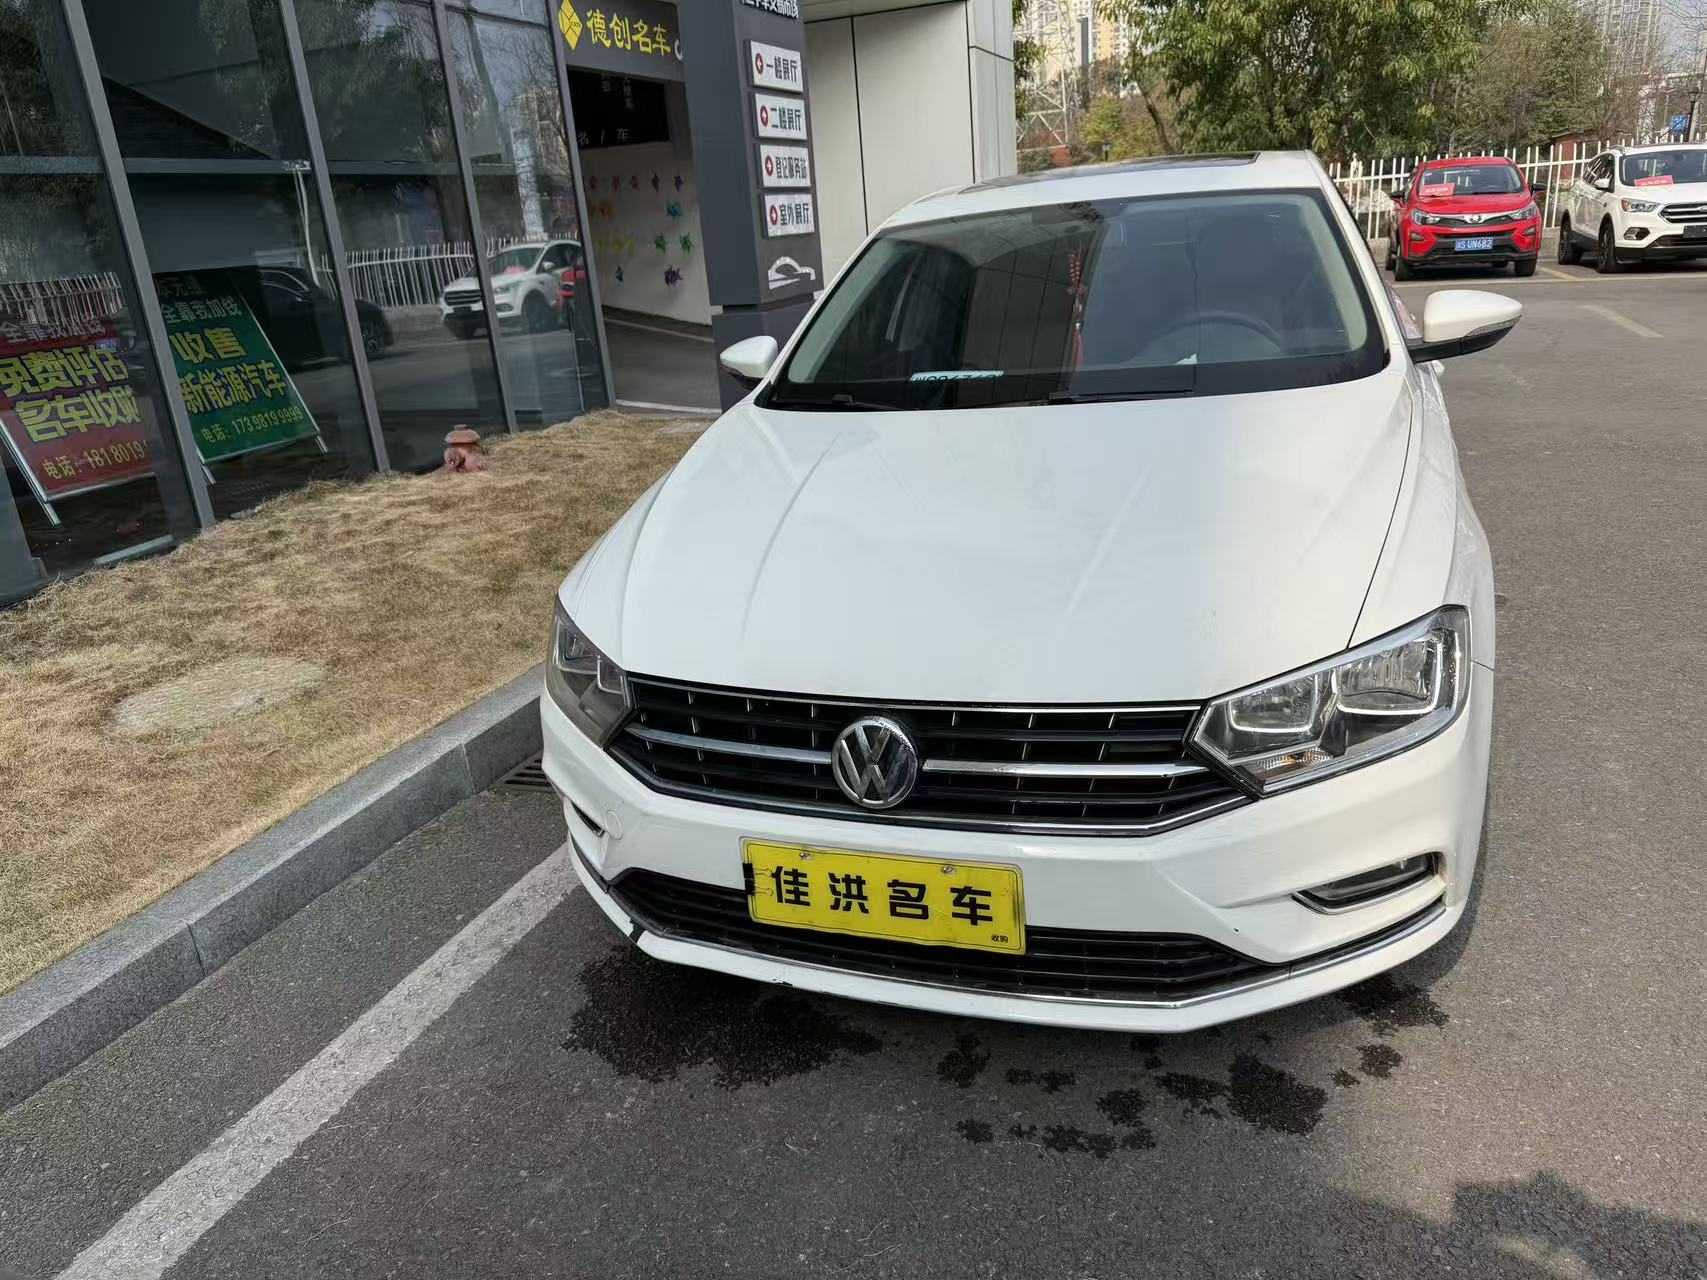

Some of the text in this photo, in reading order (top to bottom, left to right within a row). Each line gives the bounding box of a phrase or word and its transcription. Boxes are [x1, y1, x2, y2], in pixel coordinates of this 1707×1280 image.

[586, 8, 672, 56] 德创名车
[766, 56, 797, 82] 一楼展厅
[771, 106, 801, 131] 二楼展厅
[780, 203, 810, 226] 室外展厅
[169, 328, 247, 363] 收售
[0, 345, 129, 398] 免费评估
[180, 360, 286, 413] 新能源汽车
[771, 866, 993, 925] 佳洪名车
